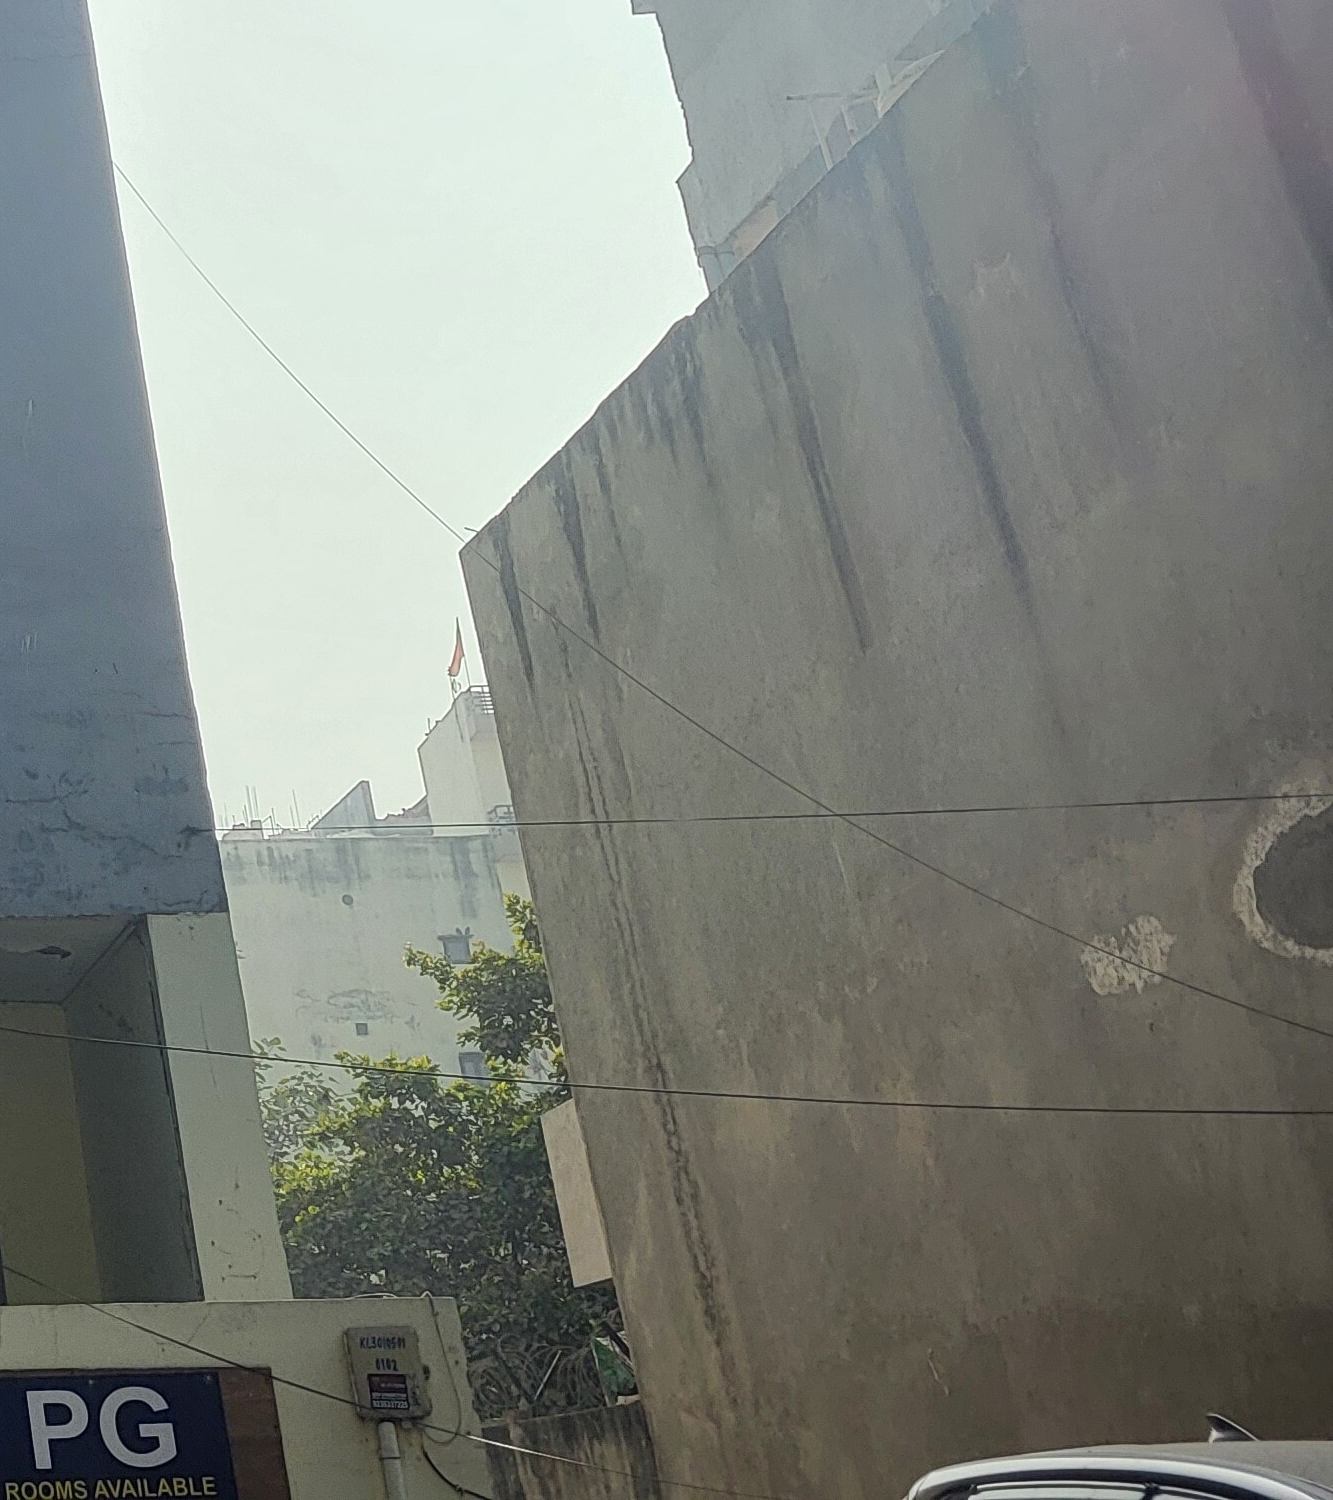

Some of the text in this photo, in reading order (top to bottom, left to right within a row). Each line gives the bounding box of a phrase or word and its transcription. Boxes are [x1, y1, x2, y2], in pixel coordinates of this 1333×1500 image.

[25, 1386, 178, 1470] PG
[4, 1476, 218, 1500] ROOMS AVAILABLE
